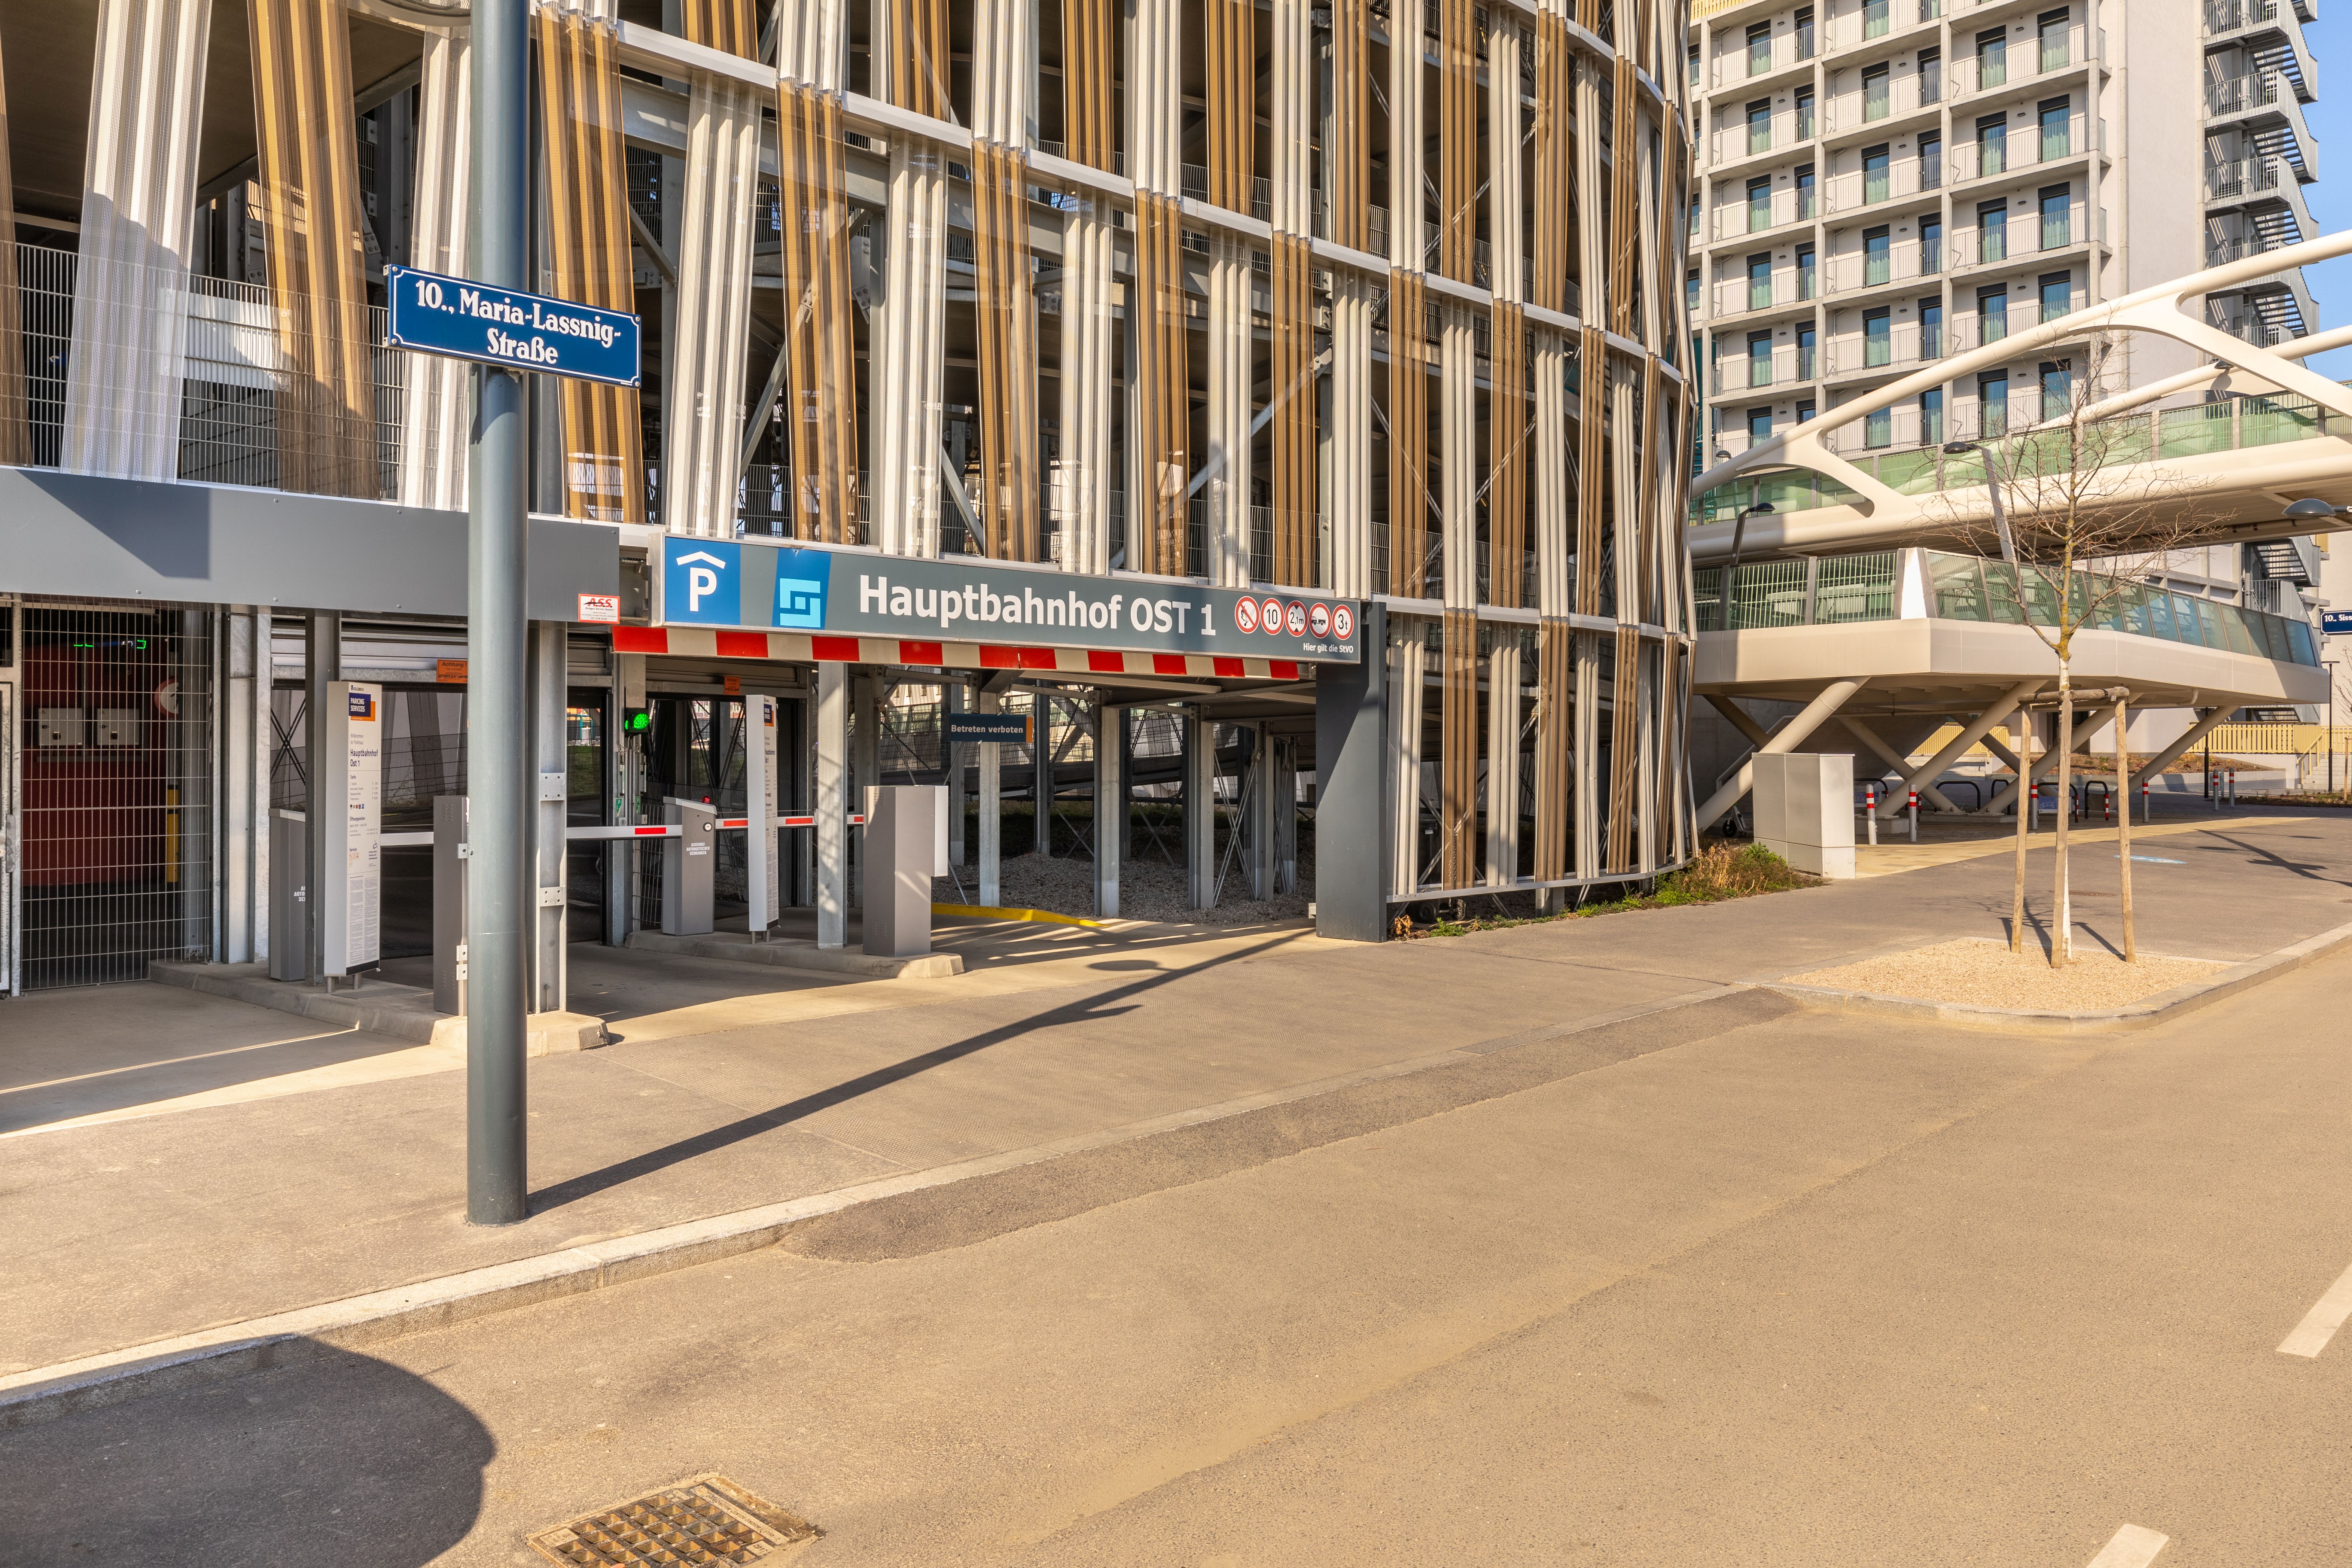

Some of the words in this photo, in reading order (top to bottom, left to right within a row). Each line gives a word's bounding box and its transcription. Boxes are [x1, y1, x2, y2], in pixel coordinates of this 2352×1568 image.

[415, 279, 454, 315] 10.,
[460, 288, 621, 348] Maria-Lassnig-
[487, 328, 558, 365] Straße
[689, 567, 717, 612] P
[588, 598, 613, 608] A.S.S.
[859, 574, 1121, 629] Hauptbahnhof
[1130, 597, 1191, 634] OST
[1201, 604, 1216, 636] 1
[1266, 609, 1278, 625] 10
[1303, 643, 1316, 651] Hier
[1317, 644, 1328, 653] gilt
[1339, 645, 1354, 653] StVO
[951, 724, 986, 734] Betreten
[988, 725, 1024, 735] verboten
[350, 749, 378, 758] Hauptbahnhof
[752, 1544, 768, 1554] 2017
